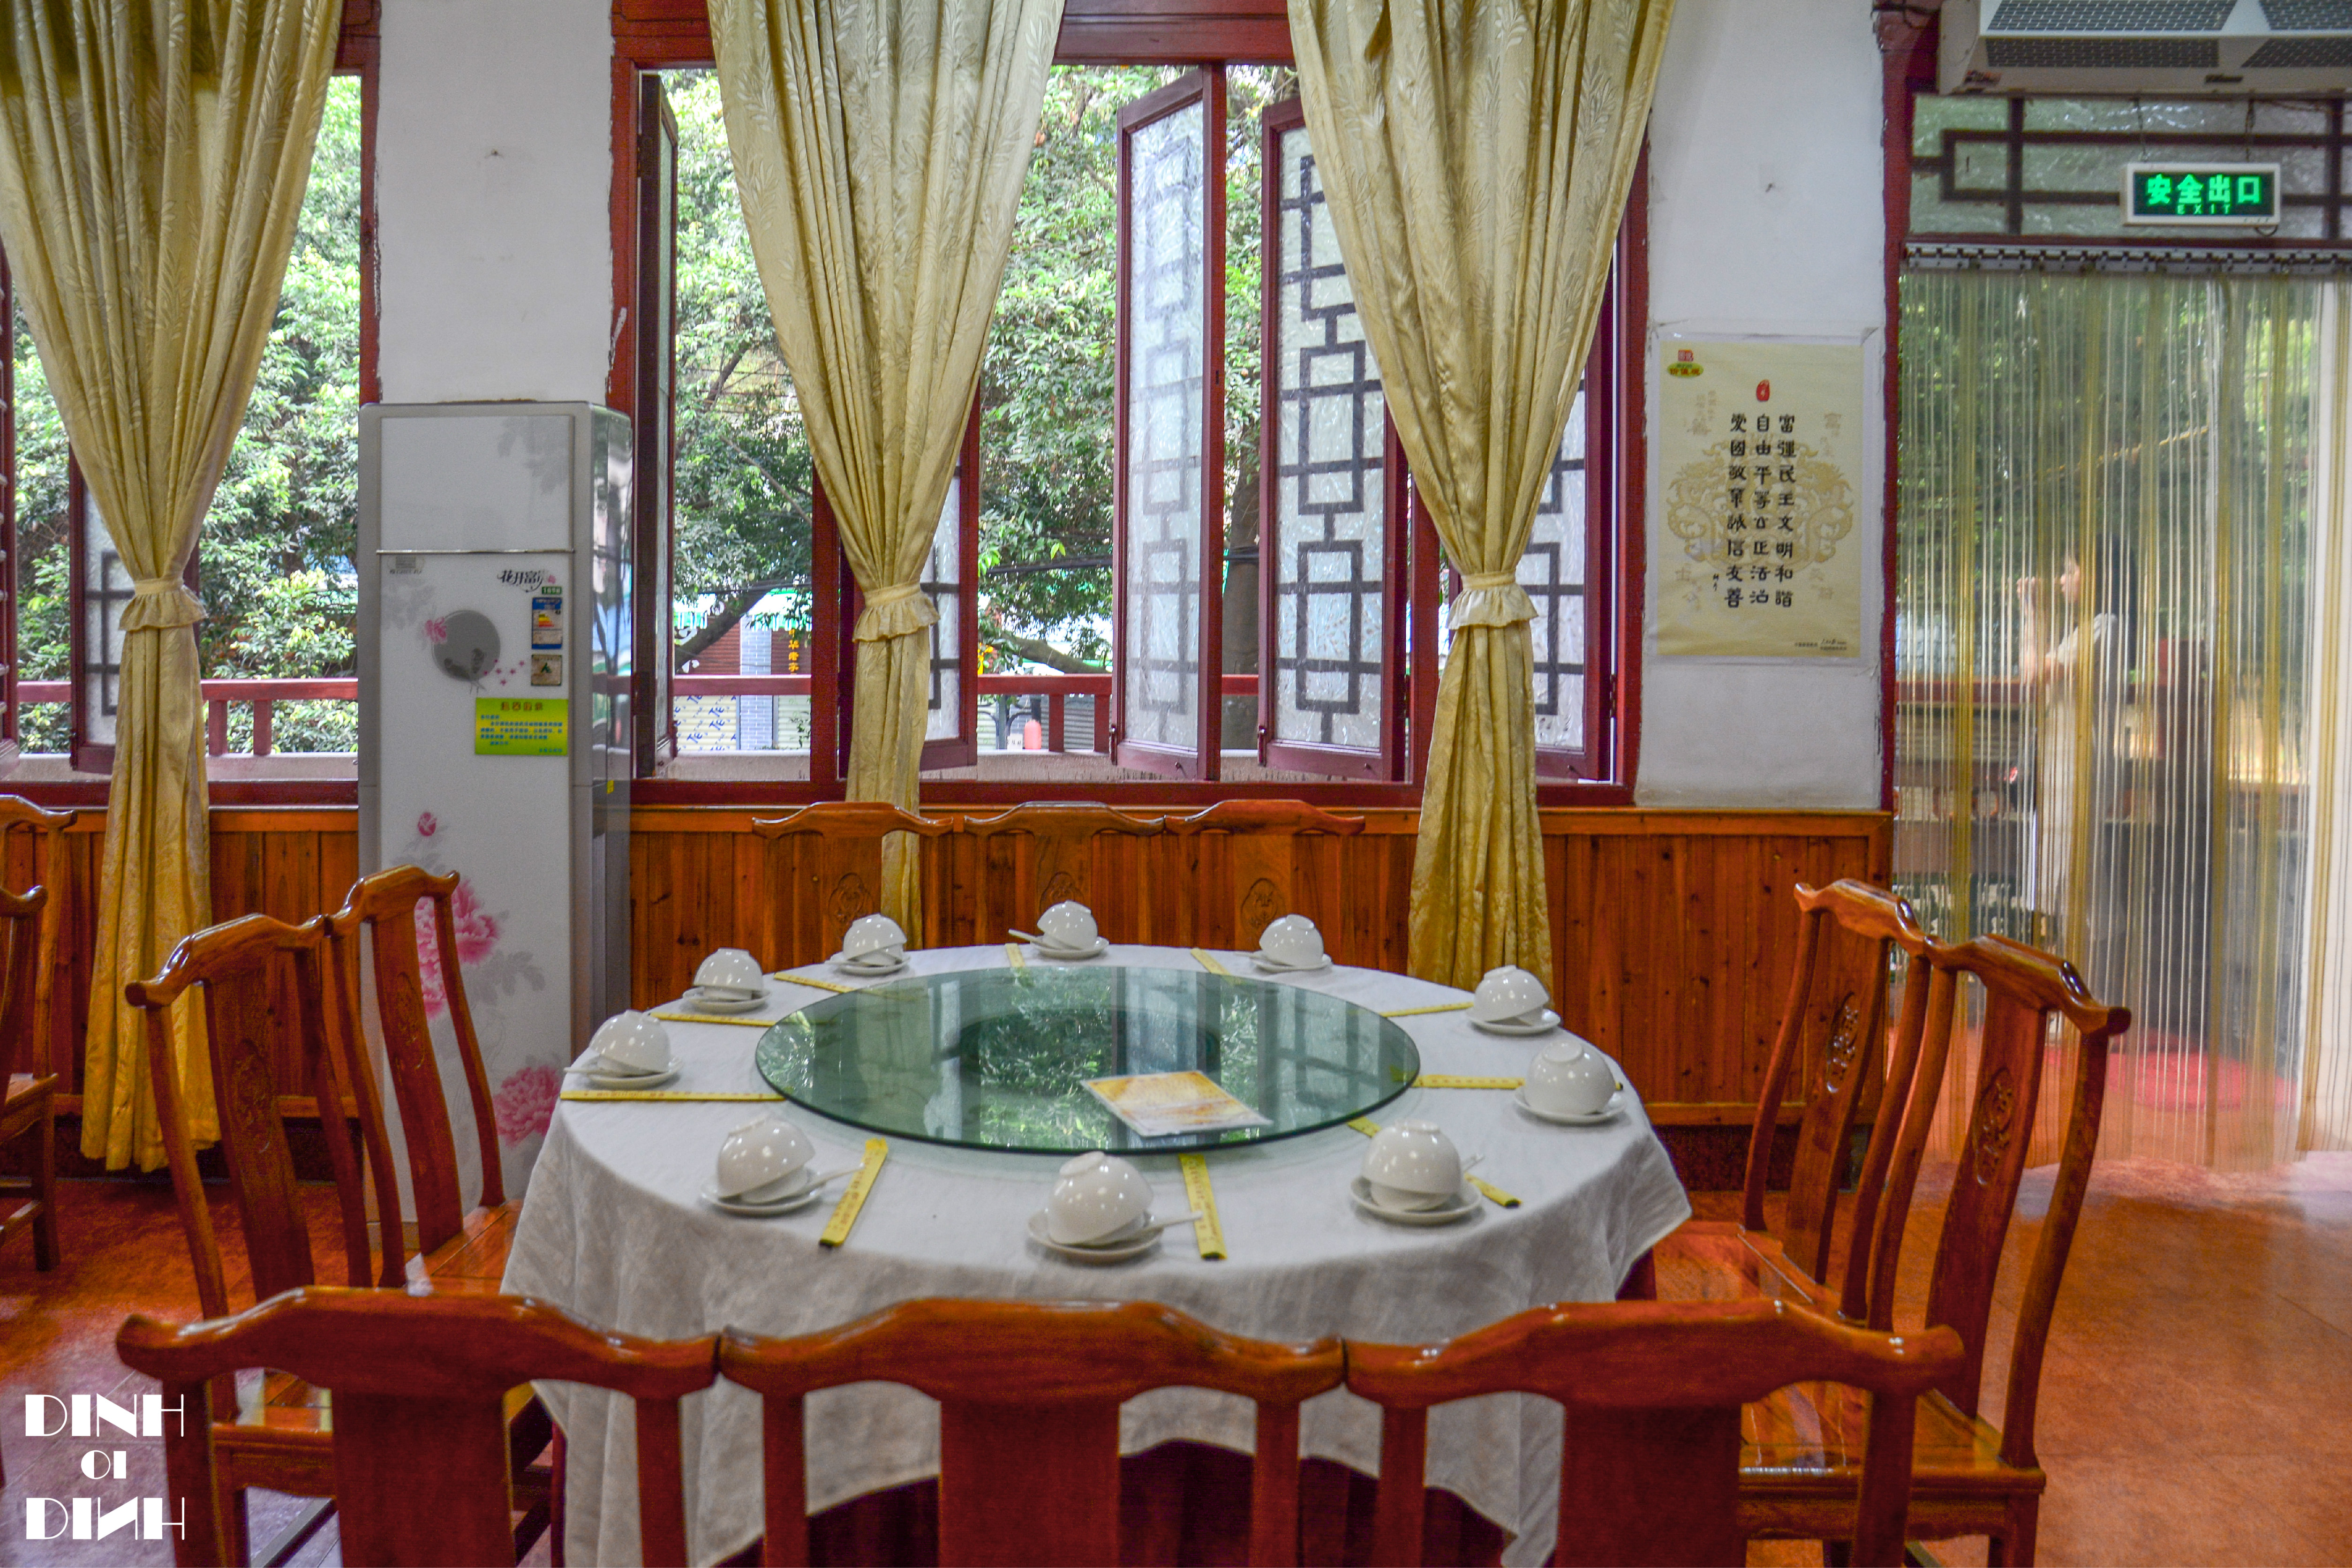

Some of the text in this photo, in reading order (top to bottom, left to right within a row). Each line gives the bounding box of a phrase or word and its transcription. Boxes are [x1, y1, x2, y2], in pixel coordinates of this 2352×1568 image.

[2148, 173, 2261, 204] 安全出口
[2177, 204, 2231, 215] EXIT
